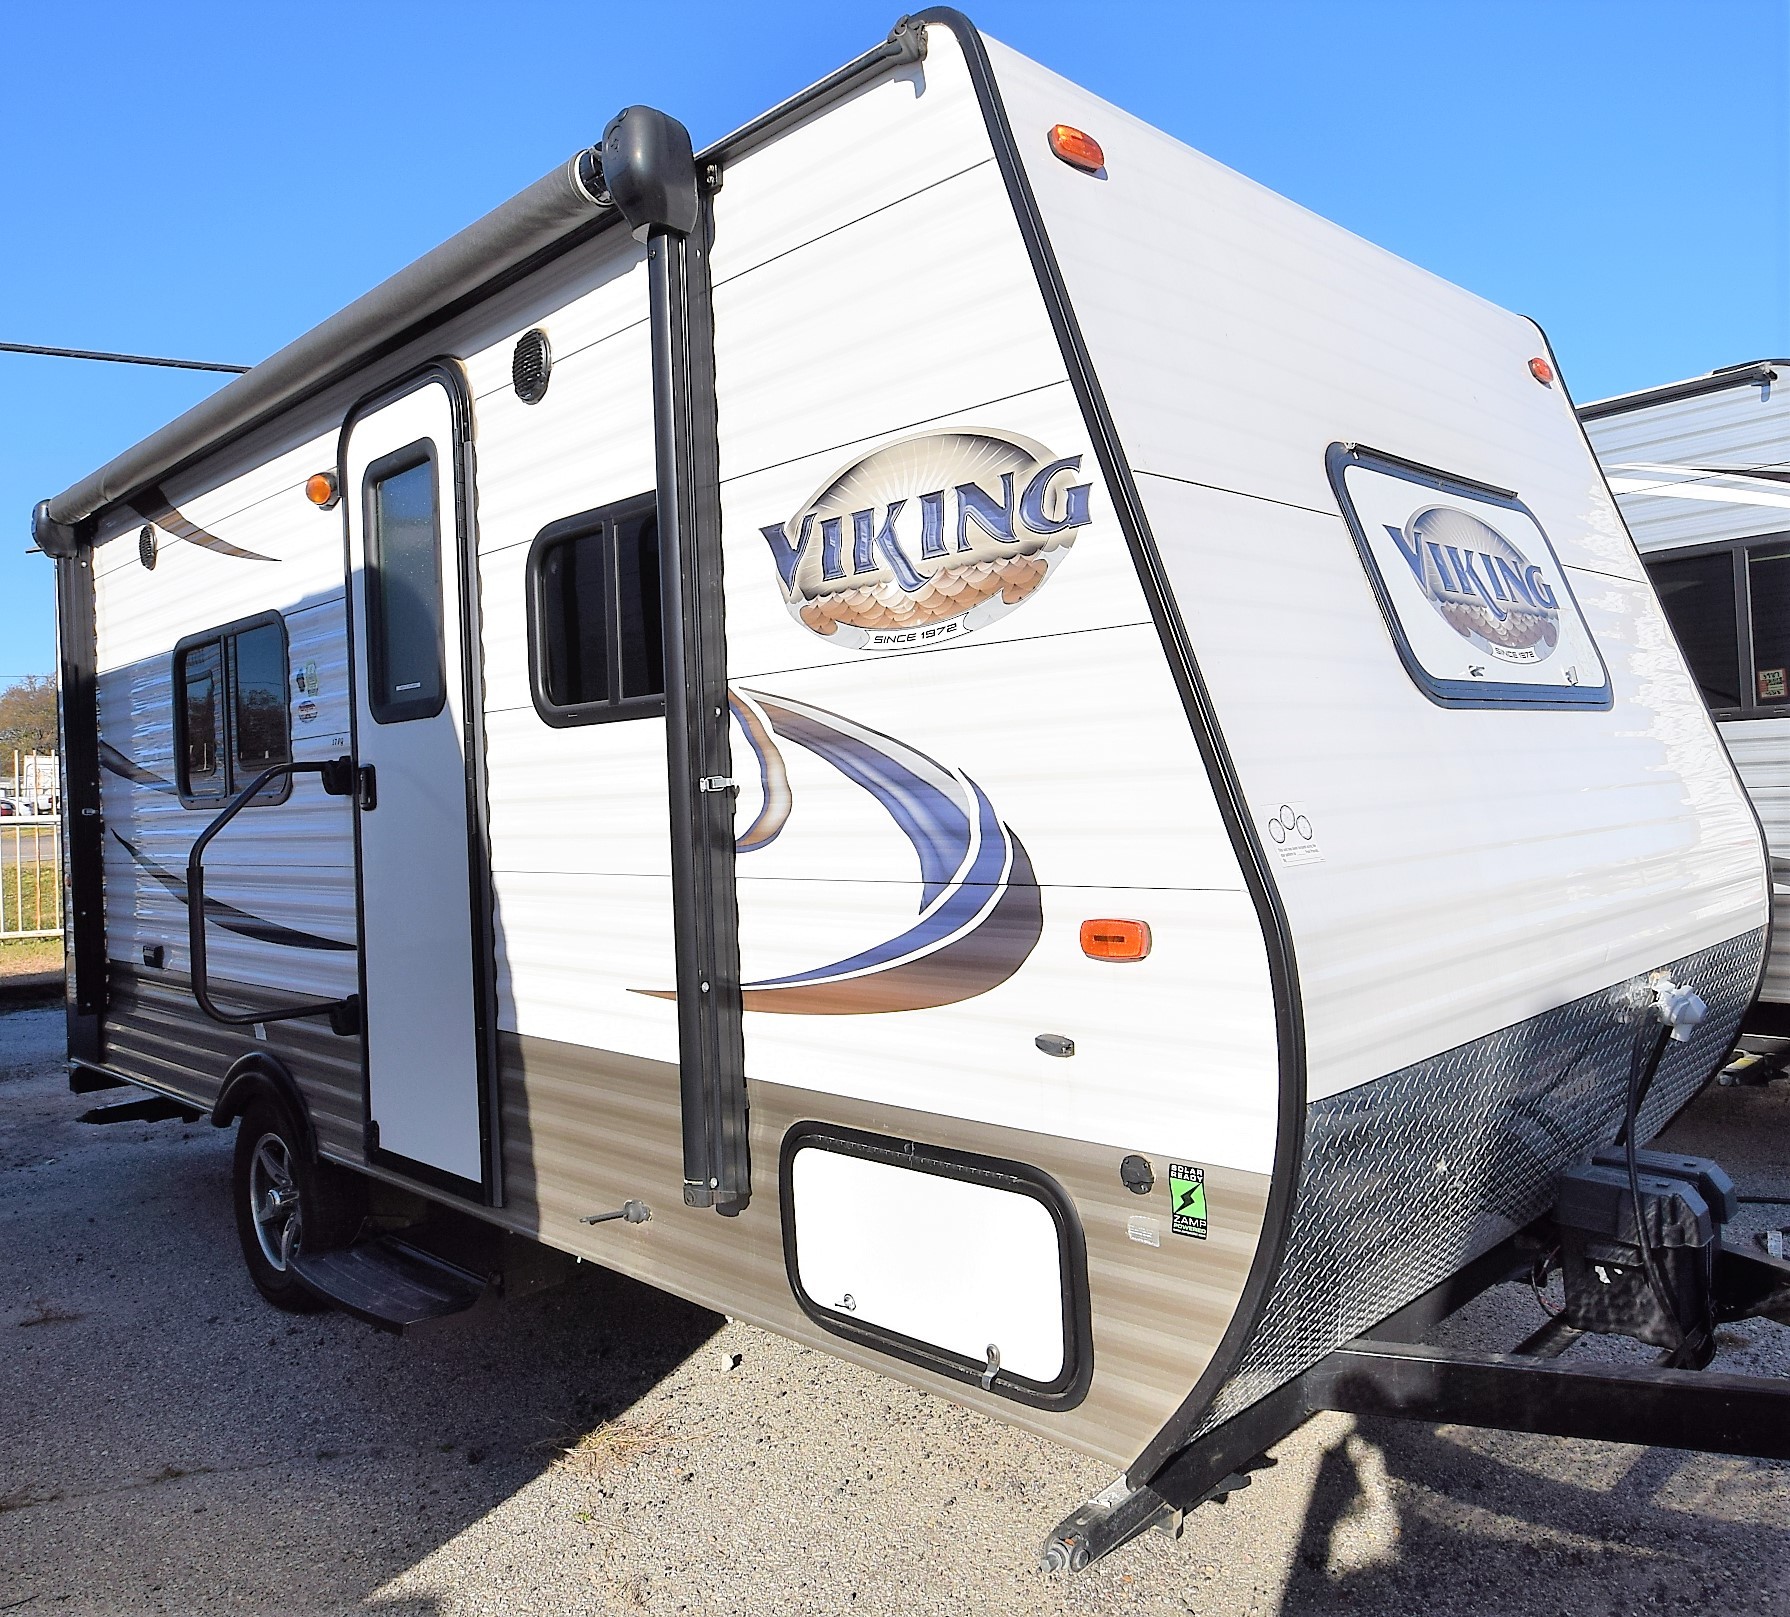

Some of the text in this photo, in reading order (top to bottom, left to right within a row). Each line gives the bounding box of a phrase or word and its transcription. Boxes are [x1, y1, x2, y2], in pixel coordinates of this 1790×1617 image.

[758, 454, 1094, 594] VIKING
[1382, 524, 1561, 621] VIKING
[873, 622, 957, 644] SINCE 1972
[1170, 1165, 1203, 1177] SOLAR
[1170, 1171, 1204, 1183] READY
[1173, 1214, 1207, 1228] ZAMP
[1173, 1222, 1207, 1234] POWERED
